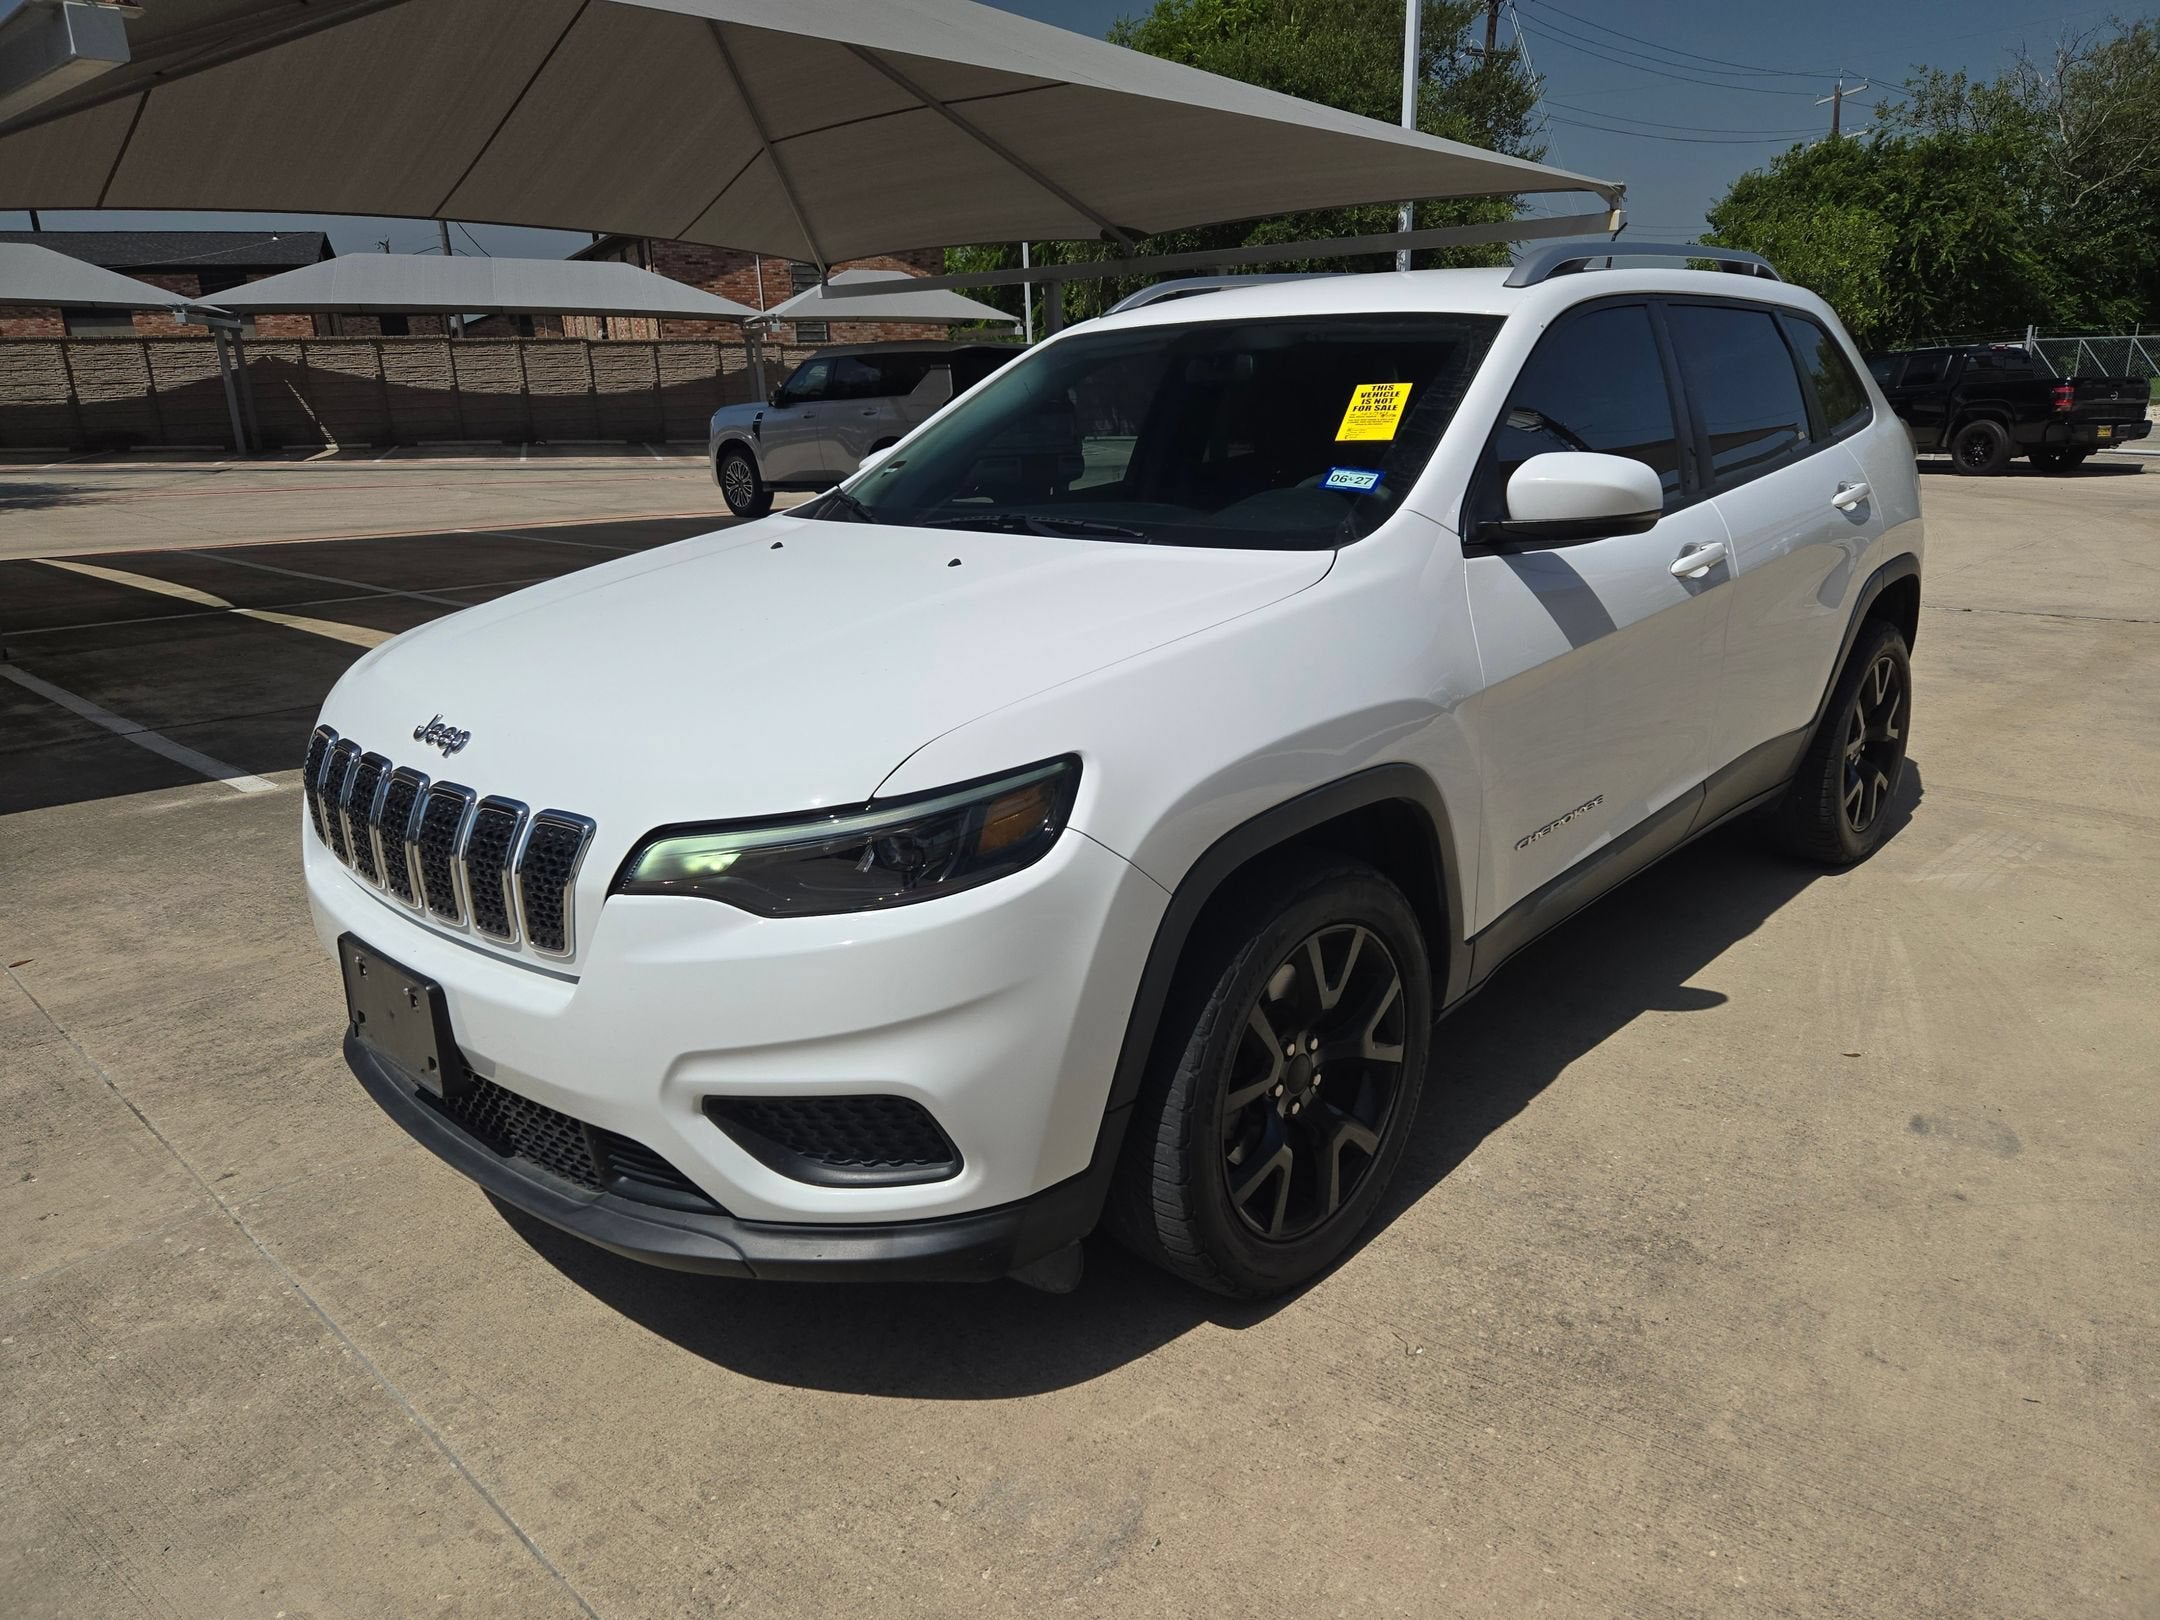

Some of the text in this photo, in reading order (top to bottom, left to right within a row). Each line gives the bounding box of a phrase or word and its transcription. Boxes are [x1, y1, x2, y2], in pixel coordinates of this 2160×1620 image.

[1331, 474, 1374, 485] 06 27
[413, 713, 471, 758] Jeep
